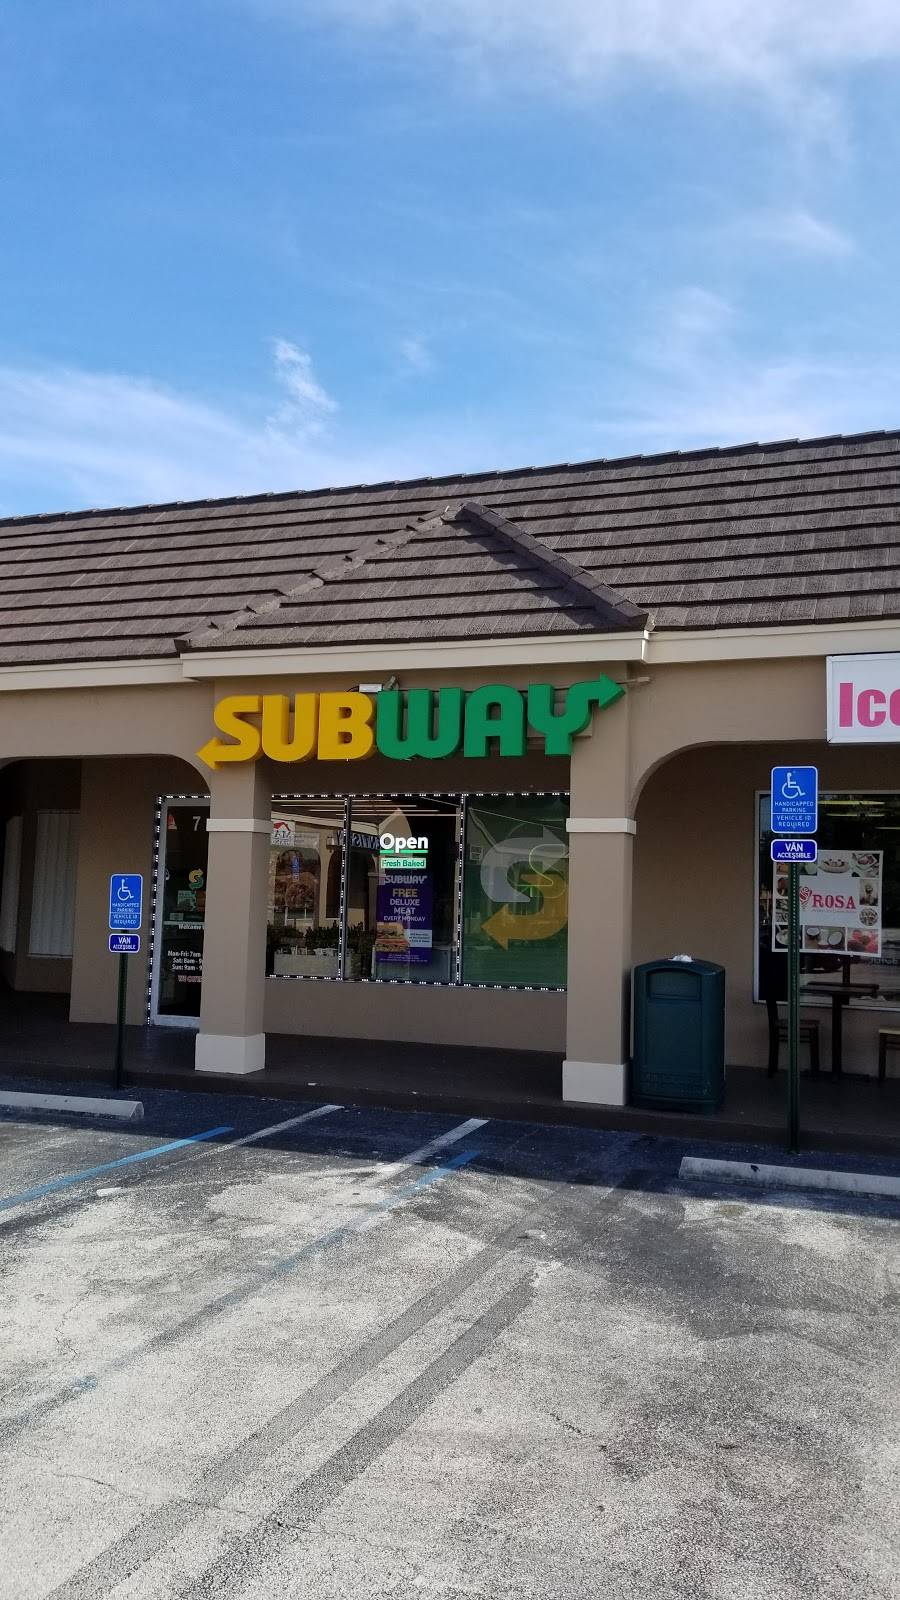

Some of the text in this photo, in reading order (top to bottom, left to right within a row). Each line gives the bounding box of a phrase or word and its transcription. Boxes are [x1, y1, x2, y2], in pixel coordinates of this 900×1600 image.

[195, 673, 624, 769] SUBWAY
[380, 833, 428, 853] Open
[784, 842, 804, 852] VAN
[382, 859, 425, 867] Fresh Baked
[384, 875, 428, 884] SUBWAY
[392, 888, 418, 897] FREE
[389, 898, 420, 906] DELUXE
[812, 894, 856, 909] ROSA
[393, 907, 416, 915] MEAT
[118, 936, 131, 944] VAN
